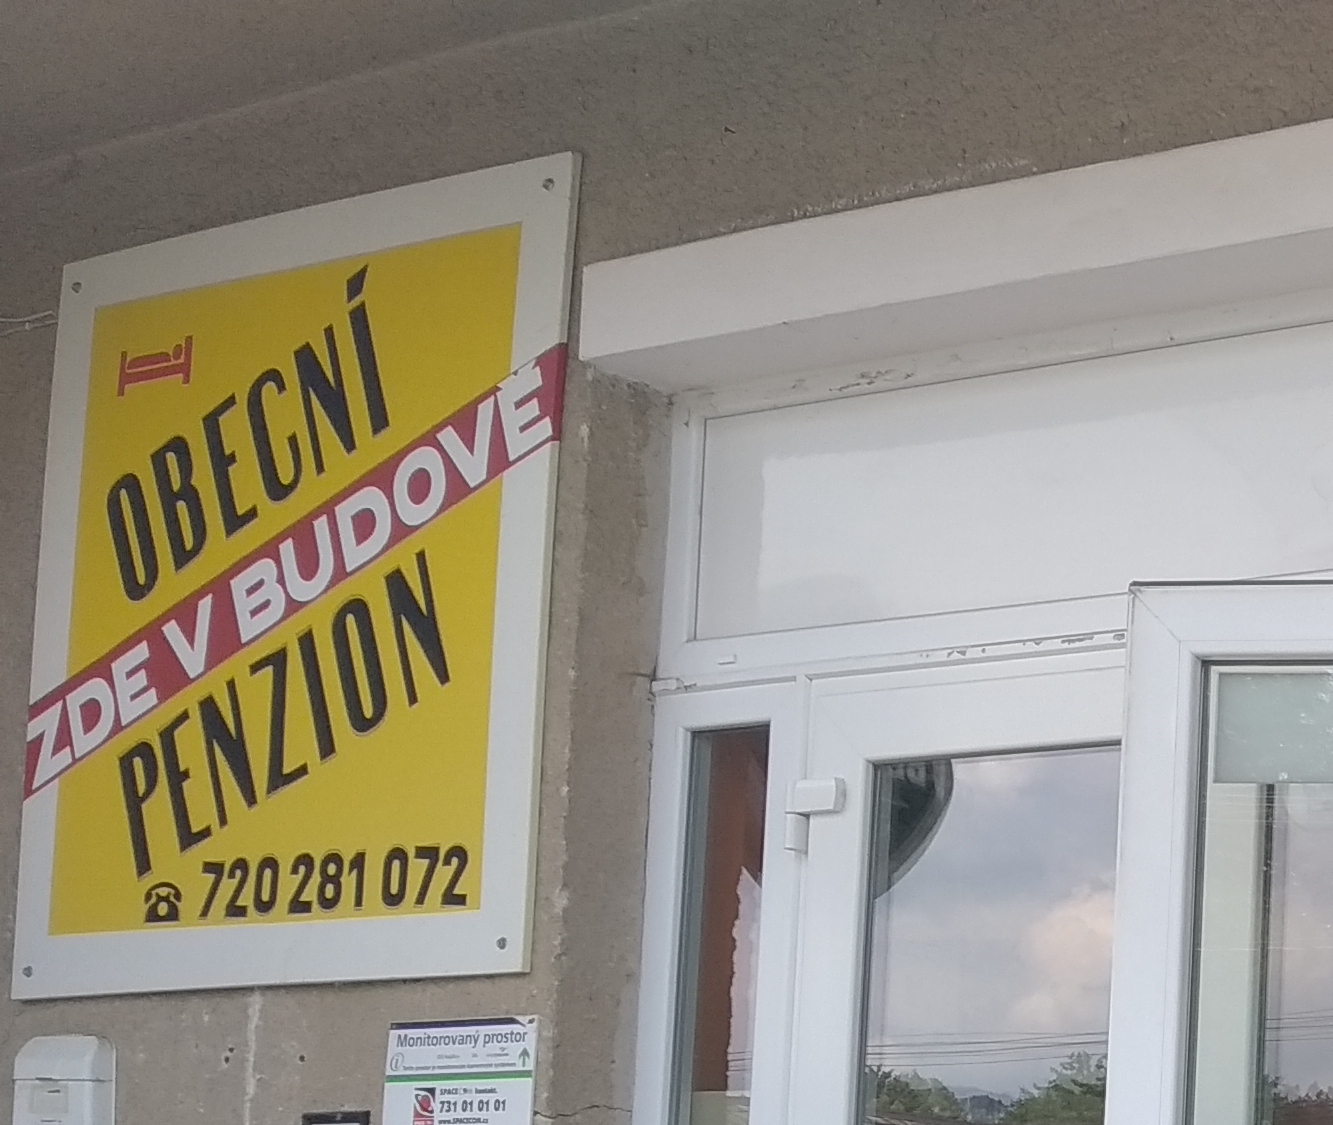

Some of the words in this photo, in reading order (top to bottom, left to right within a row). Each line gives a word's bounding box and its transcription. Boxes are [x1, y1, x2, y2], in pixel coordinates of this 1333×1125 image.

[106, 264, 391, 602] OBECNÍ
[26, 641, 158, 796] ZDE
[160, 593, 213, 680] V
[230, 356, 554, 647] BUDOVĚ
[117, 550, 451, 880] PENZION
[199, 856, 281, 919] 720
[289, 850, 367, 910] 281
[381, 845, 469, 907] 072
[396, 1030, 480, 1049] Monitorovaný
[482, 1030, 528, 1048] prostor
[439, 1100, 458, 1113] 731
[461, 1100, 474, 1113] 01
[477, 1099, 490, 1112] 01
[493, 1098, 507, 1112] 01
